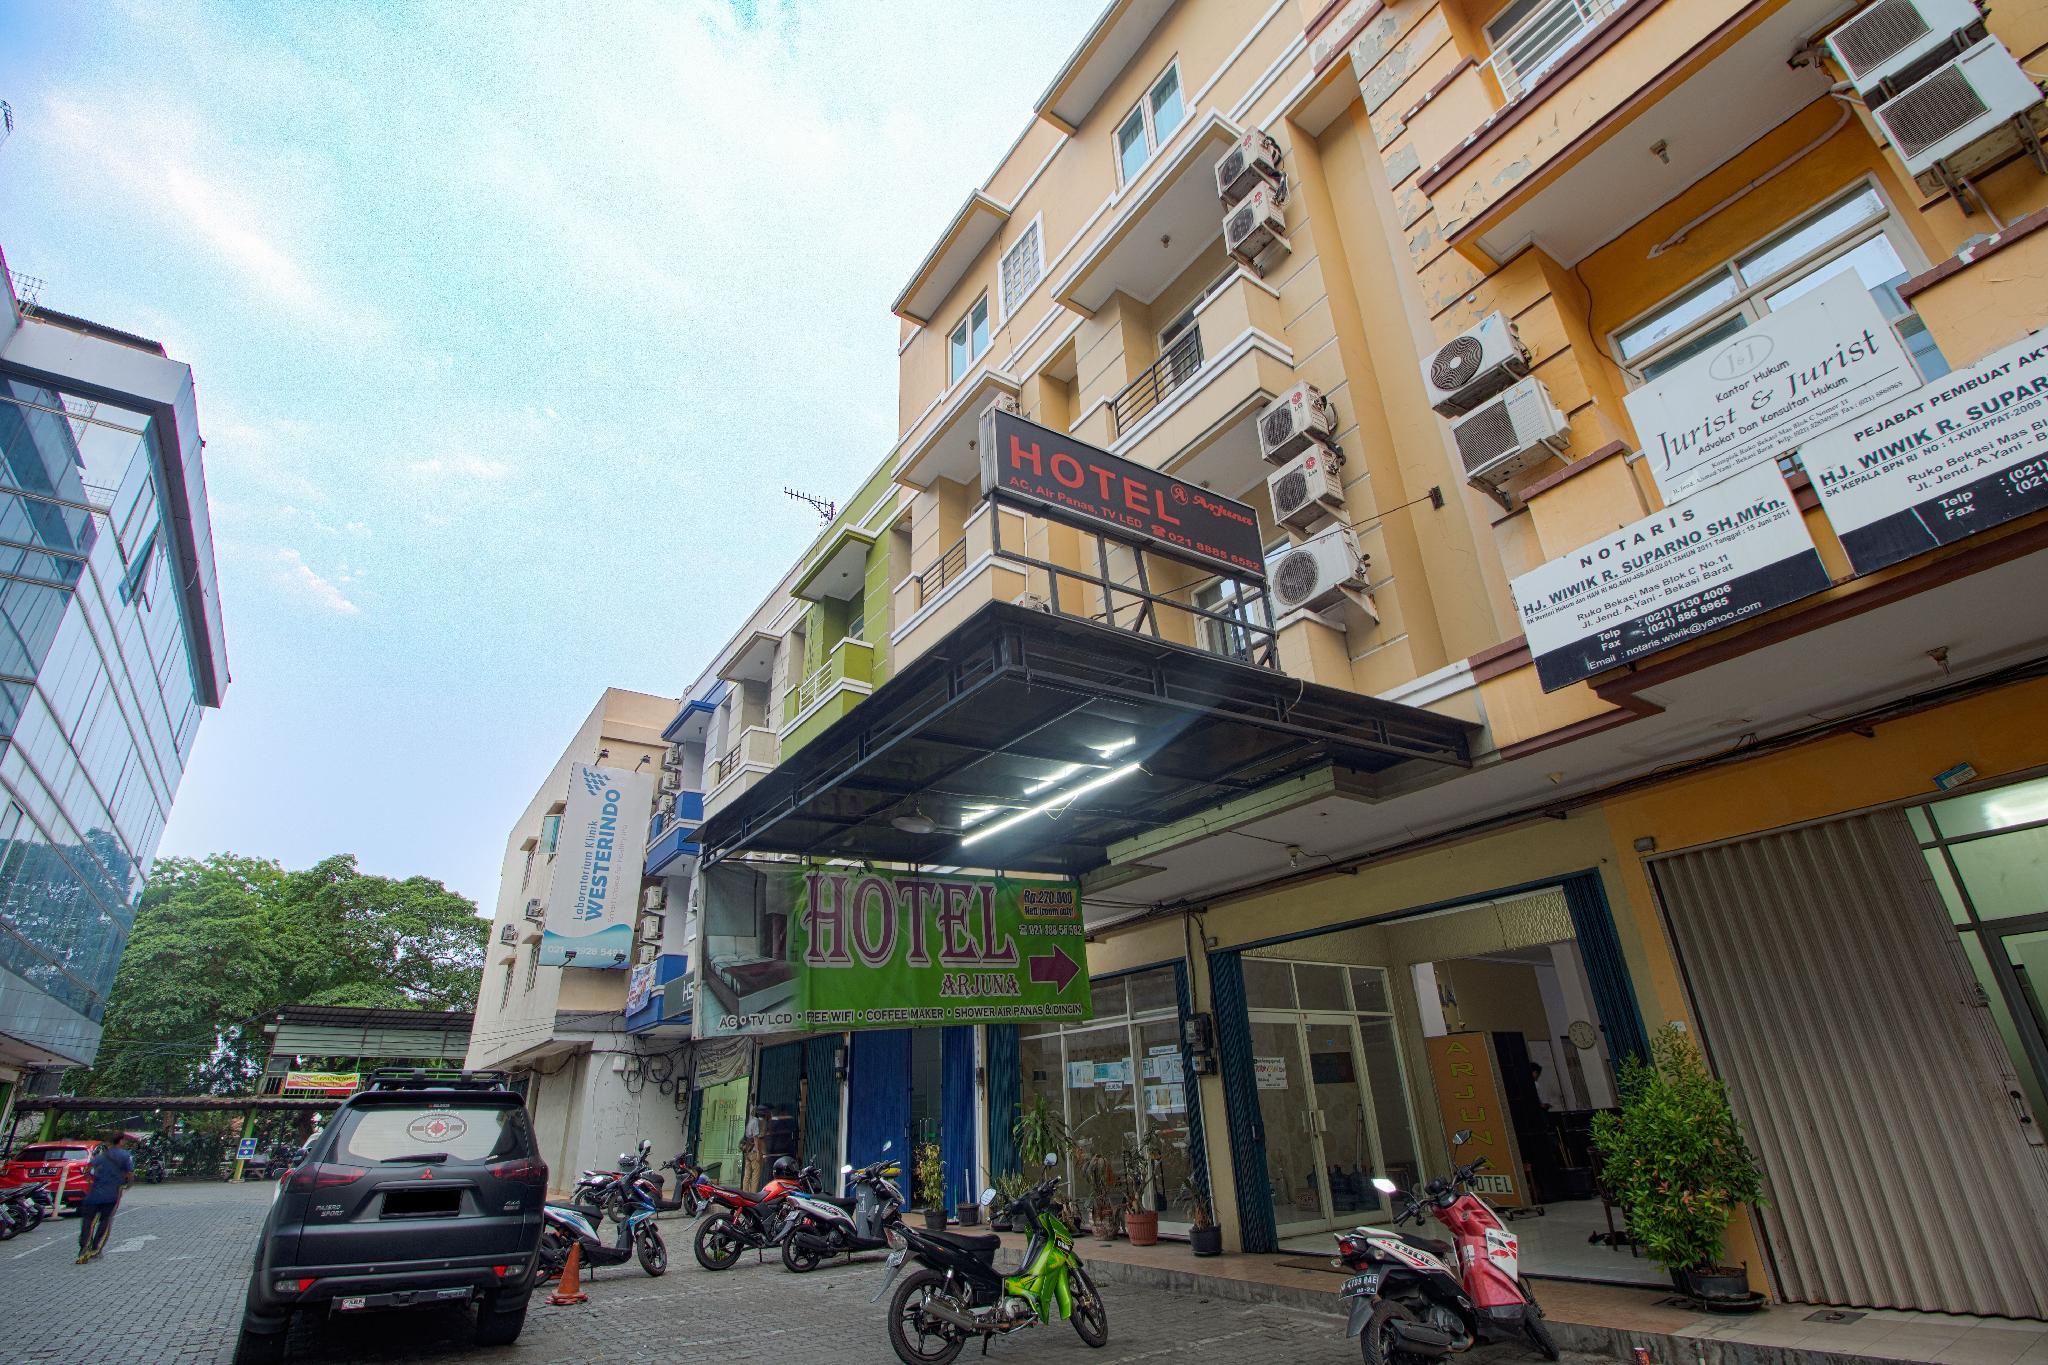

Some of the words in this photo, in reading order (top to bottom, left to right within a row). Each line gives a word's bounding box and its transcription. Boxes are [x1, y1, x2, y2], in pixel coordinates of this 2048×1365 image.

[1657, 407, 1737, 472] Jurist
[1750, 388, 1774, 411] &
[1786, 328, 1879, 398] Jurist
[1715, 380, 1750, 403] Kantor
[1753, 359, 1790, 384] Hukum
[1853, 402, 1925, 442] PEJABAT
[1929, 362, 2011, 407] PEMBUAT
[1698, 432, 1735, 456] Advokat
[1739, 420, 1759, 436] Dan
[1760, 395, 1810, 424] Konsultan
[1811, 375, 1849, 398] Hukum
[1819, 464, 1856, 487] HJ.
[1857, 428, 1933, 469] WIWIK
[1935, 416, 1963, 436] R.
[1825, 487, 1840, 497] SK
[1842, 468, 1882, 489] KEPALA
[1882, 459, 1905, 473] BPN
[1905, 453, 1918, 464] RI
[1923, 444, 1939, 456] NO
[1947, 400, 2042, 444] 1-XVII-PPAT-2009
[1906, 465, 1944, 484] Ruko
[1946, 441, 1994, 467] Bekasi
[1996, 429, 2028, 445] Mas
[1915, 481, 1933, 492] Jl.
[1936, 465, 1974, 489] Jend.
[1009, 435, 1181, 526] HOTEL
[1010, 476, 1032, 493] AC,
[1036, 484, 1055, 498] Air
[1058, 491, 1098, 516] Panas,
[1101, 506, 1116, 520] TV
[1119, 513, 1143, 530] LED
[1168, 532, 1191, 547] 021
[1192, 495, 1254, 526] Arjuna
[1938, 491, 1974, 510] Telp
[1945, 503, 1976, 520] Fax
[1756, 519, 1772, 528] Juni
[1773, 509, 1791, 521] 2011
[1523, 599, 1547, 616] HJ.
[1548, 575, 1598, 604] WIWIK
[1602, 569, 1619, 582] R.
[1621, 530, 1702, 574] SUPARNO
[1577, 607, 1602, 621] Ruko
[1604, 591, 1638, 609] Bekasi
[1639, 583, 1661, 596] Mas
[1662, 571, 1687, 586] Blok
[1688, 567, 1697, 576] C
[1700, 553, 1729, 571] No.11
[1582, 620, 1594, 629] Jl.
[1595, 611, 1622, 624] Jend.
[1664, 578, 1700, 595] Bekasi
[1703, 563, 1734, 580] Barat
[1590, 655, 1616, 670] Email
[1626, 600, 1762, 657] notaris.wiwik@yahoo.com
[1597, 628, 1621, 642] Telp
[1644, 609, 1672, 626] (021)
[1673, 597, 1700, 612] 7130
[1703, 584, 1732, 601] 4006
[1601, 639, 1621, 651] Fax
[1648, 618, 1676, 635] (021)
[1677, 608, 1699, 622] 886
[1700, 596, 1729, 614] 8965
[584, 820, 599, 851] Klinik
[584, 788, 621, 922] WESTERINDO
[803, 873, 1018, 967] HOTEL
[719, 1015, 737, 1029] AC
[750, 1014, 765, 1026] TV
[768, 1013, 793, 1025] LCD
[831, 1010, 854, 1022] WIFI
[866, 1009, 909, 1021] COFFEE
[910, 1008, 944, 1020] MAKER
[954, 1006, 995, 1018] SHOWER
[997, 1006, 1013, 1018] AIR
[1013, 1004, 1043, 1017] PANAS
[1045, 1003, 1052, 1016] &
[1053, 1003, 1083, 1016] DINGIN
[940, 973, 1021, 998] ARJUNA
[320, 1210, 344, 1218] SPORT
